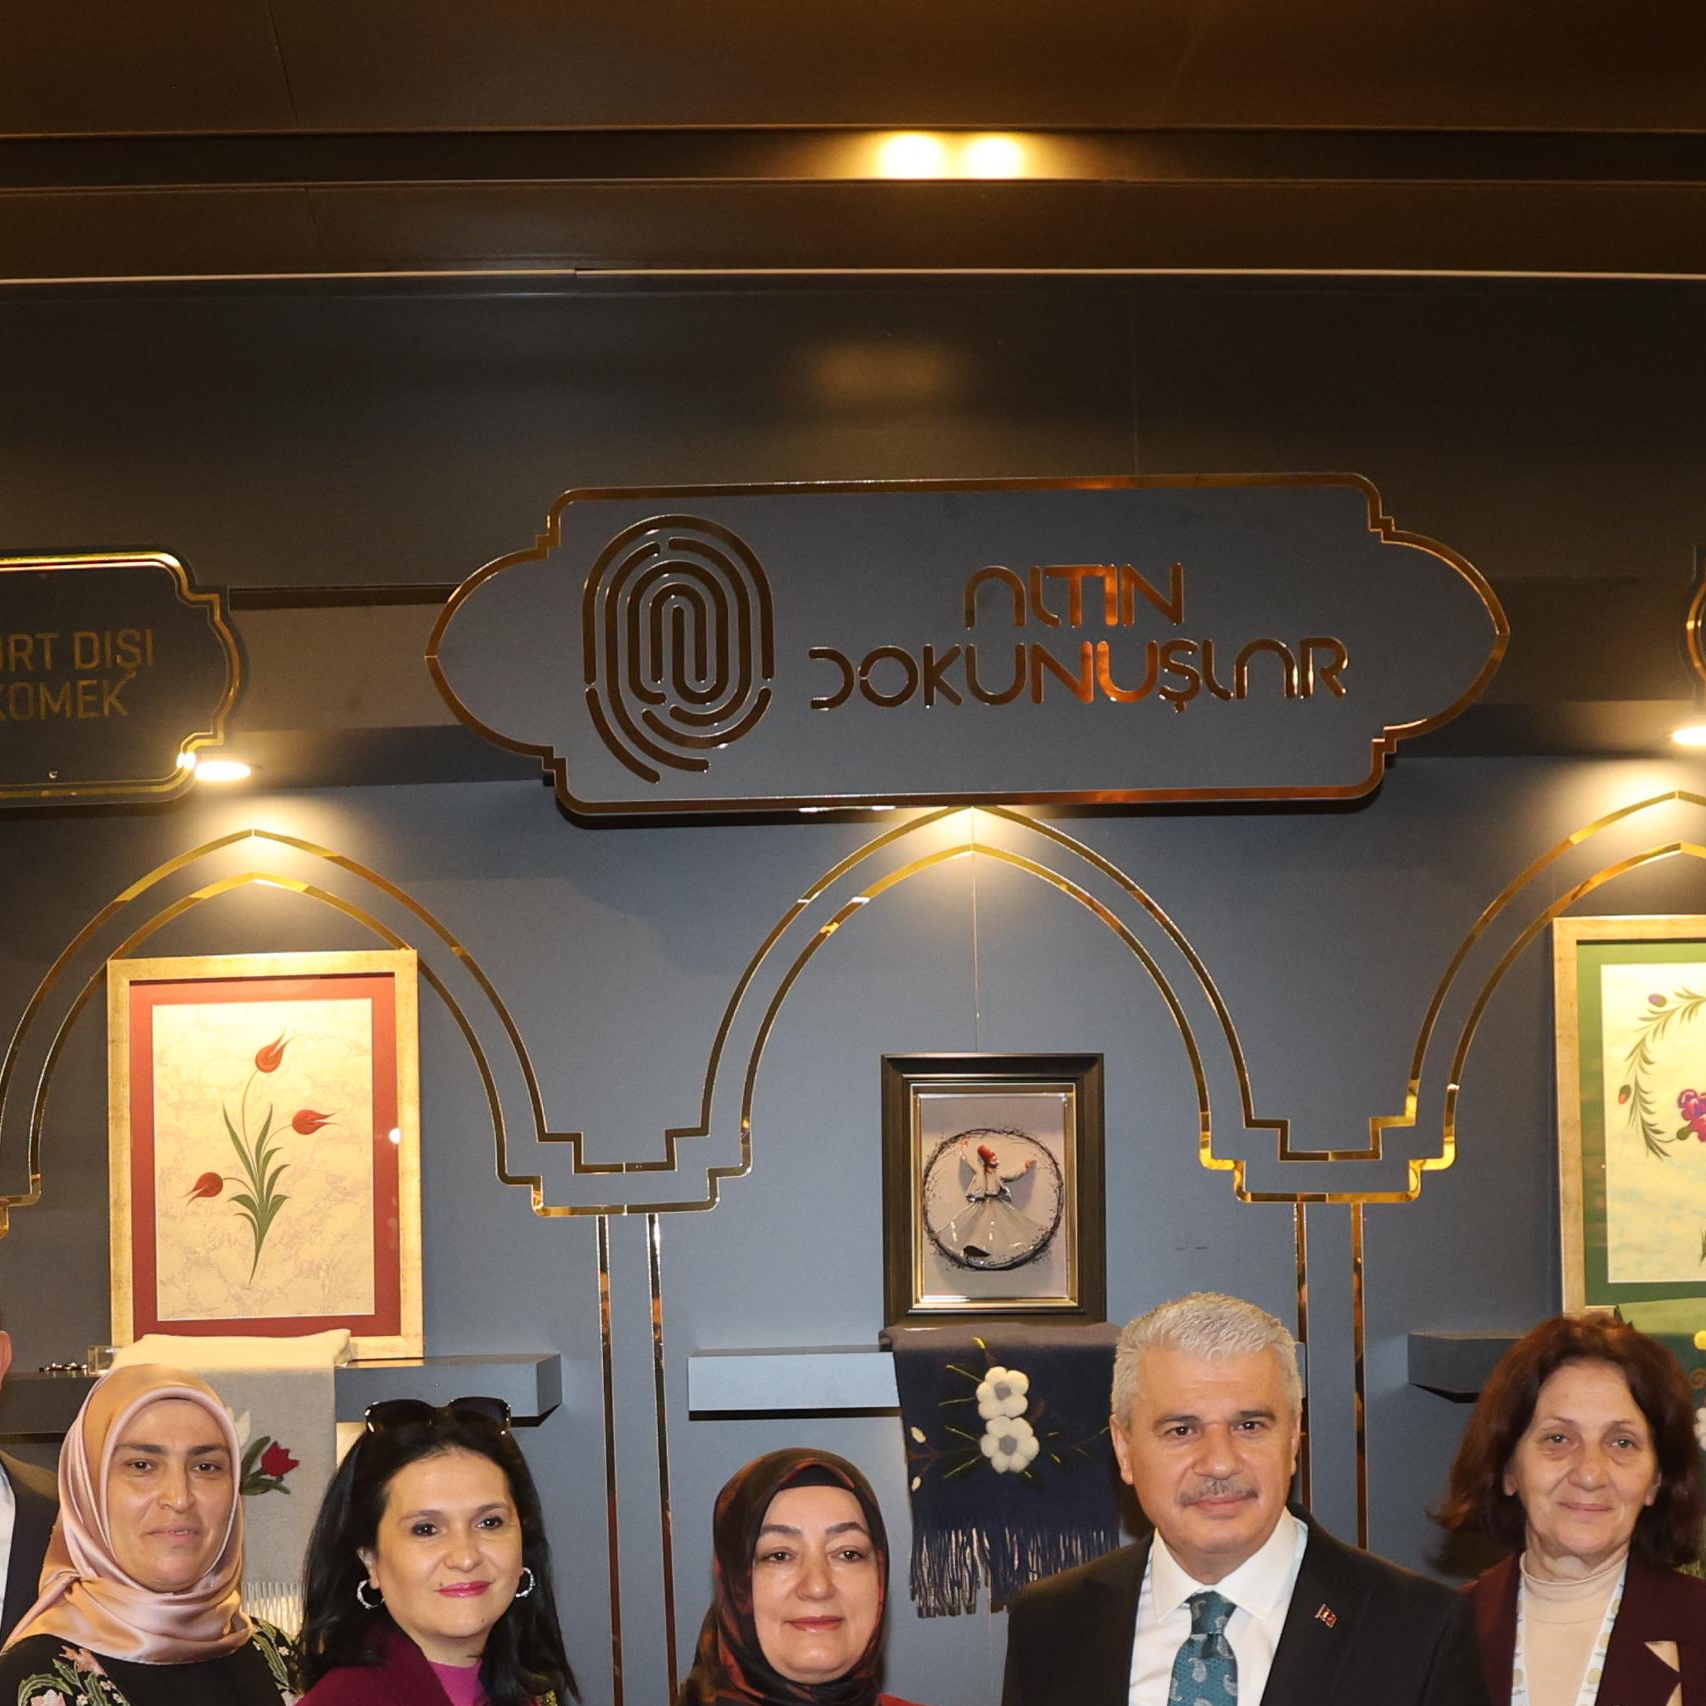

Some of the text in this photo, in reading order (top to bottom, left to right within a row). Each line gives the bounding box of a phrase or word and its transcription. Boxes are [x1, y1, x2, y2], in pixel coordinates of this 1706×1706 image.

[964, 562, 1185, 630] ALTIN
[72, 627, 156, 678] DIŞI
[807, 636, 1349, 714] DOKUNUŞLAR
